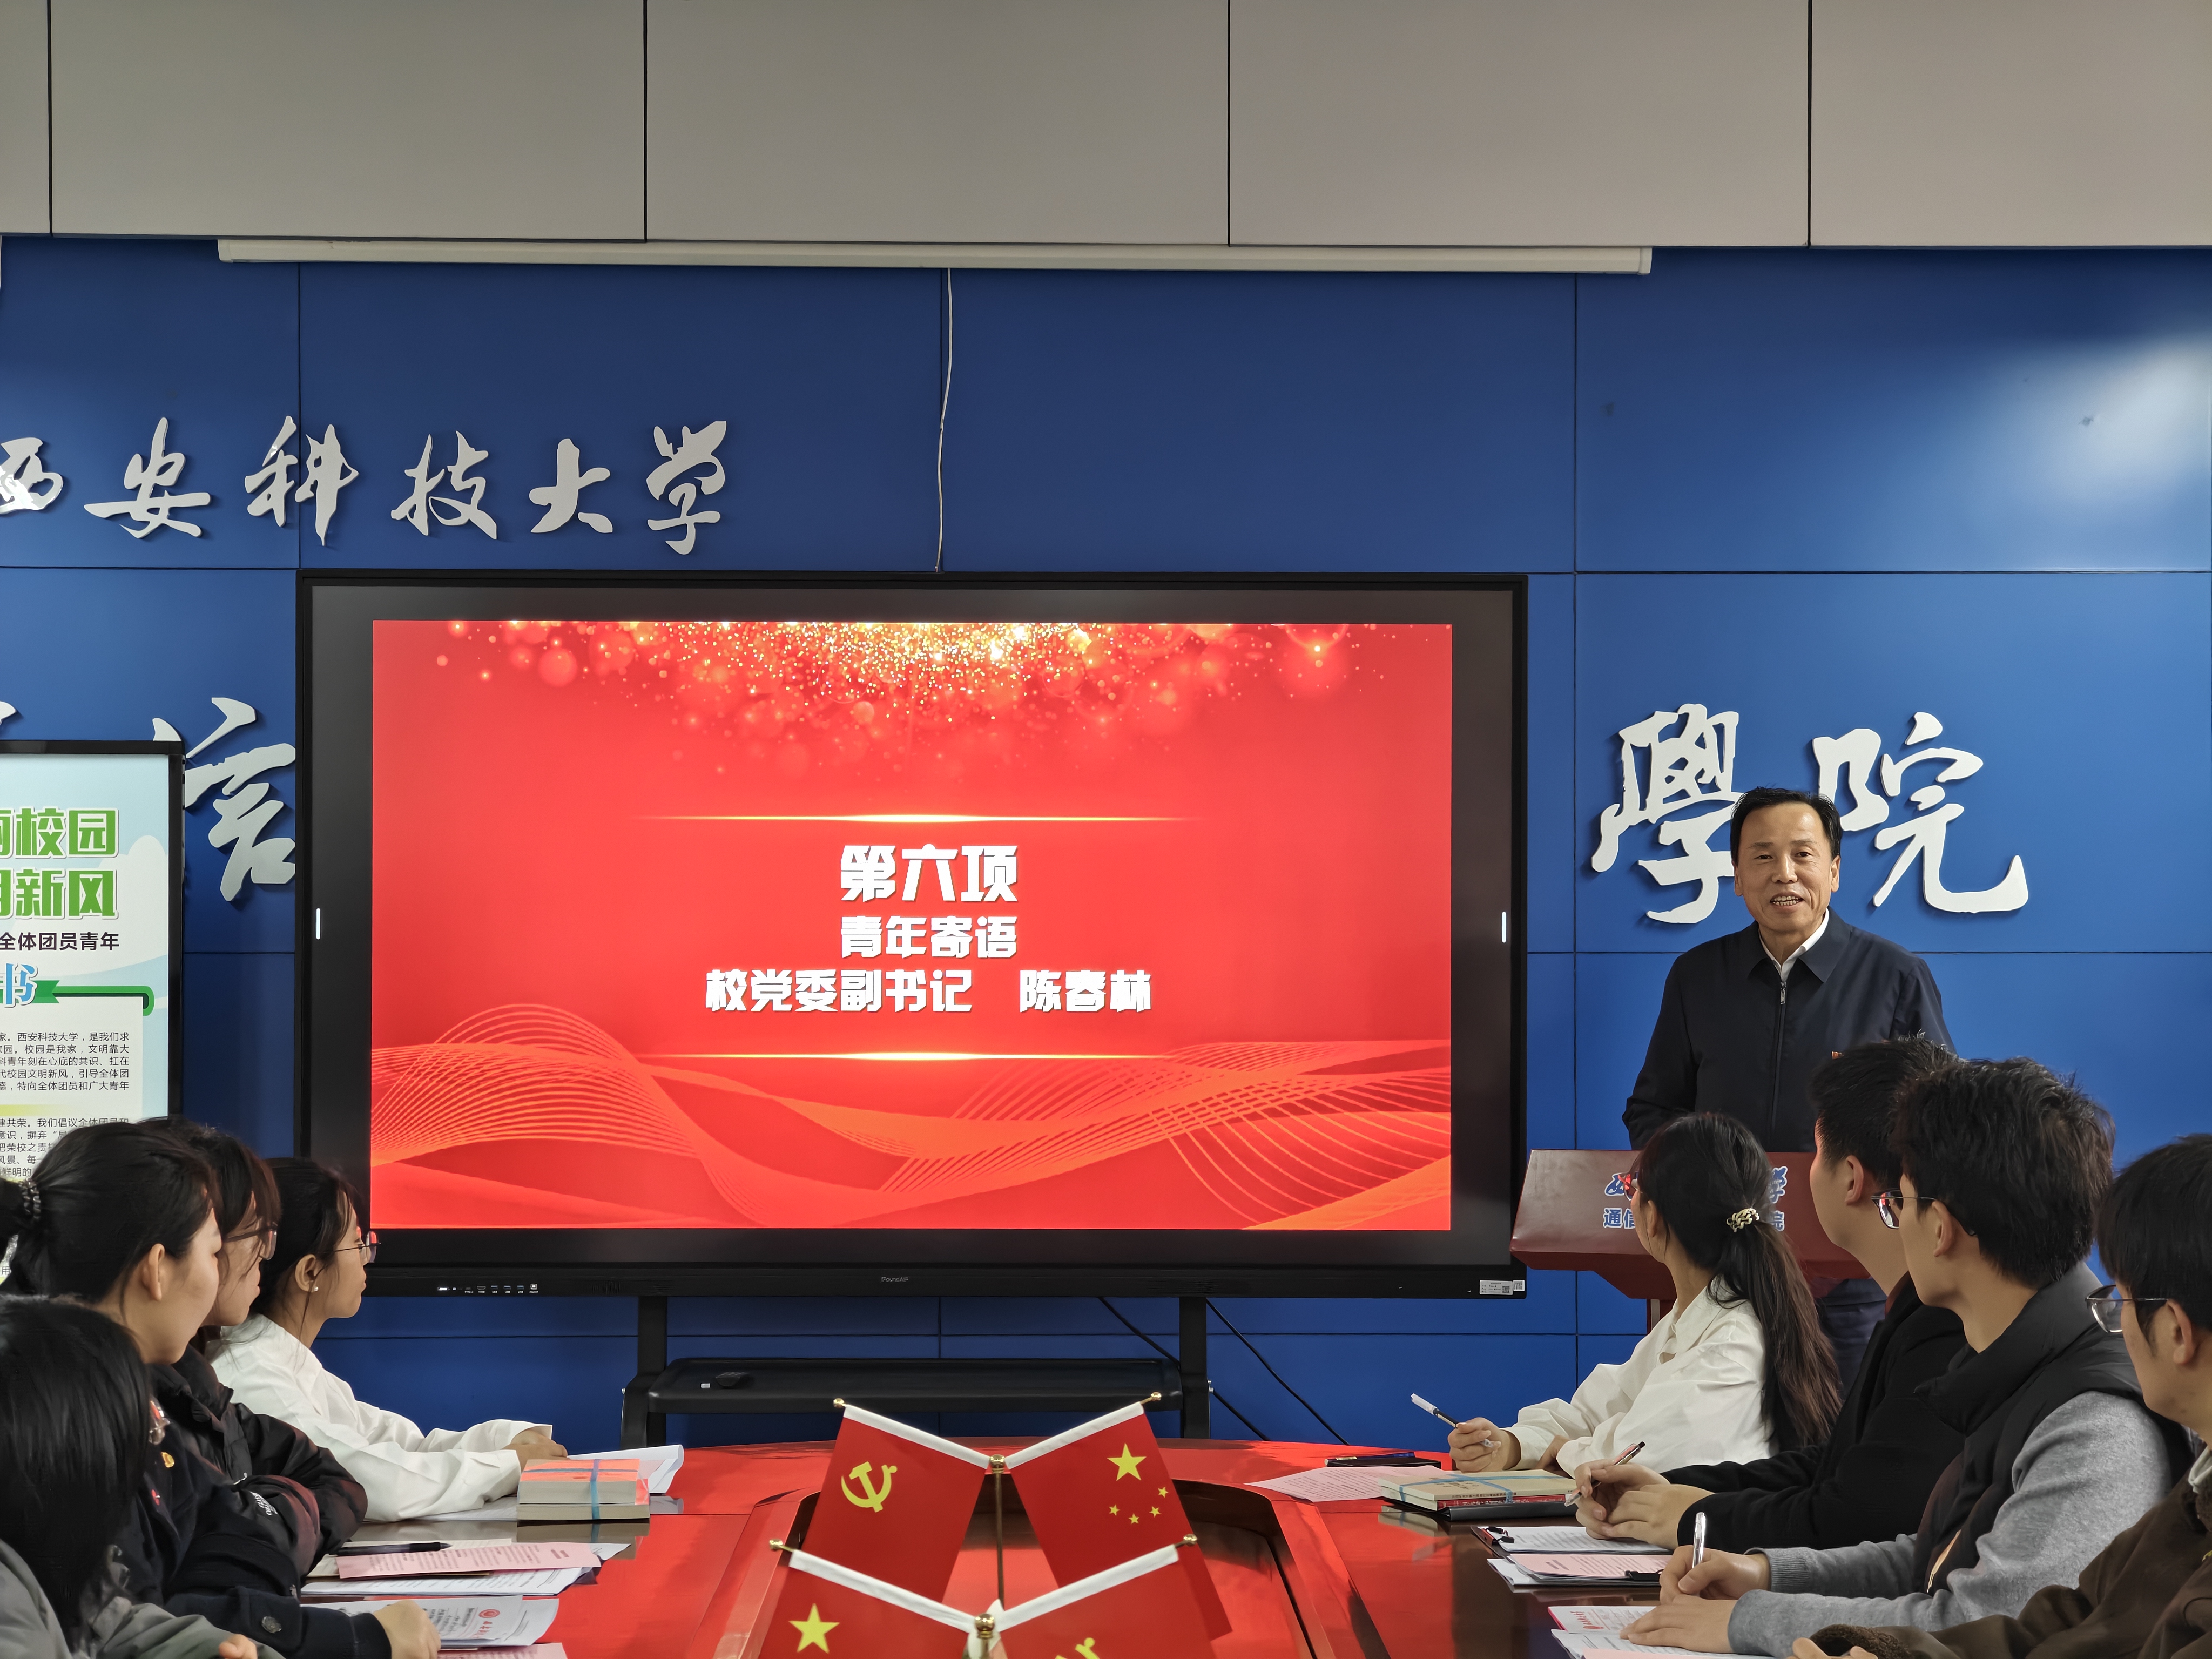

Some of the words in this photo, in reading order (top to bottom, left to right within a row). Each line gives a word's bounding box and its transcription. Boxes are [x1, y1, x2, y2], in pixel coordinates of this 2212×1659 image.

[0, 807, 117, 857] 校园
[0, 868, 117, 918] 新风
[840, 843, 1018, 902] 第六项
[0, 932, 119, 951] 全体团员青年
[840, 915, 1017, 959] 青年寄语
[705, 968, 973, 1013] 校党委副书记
[1020, 969, 1152, 1013] 陈春林
[0, 1044, 129, 1054] 园。校园是我家，文明靠大
